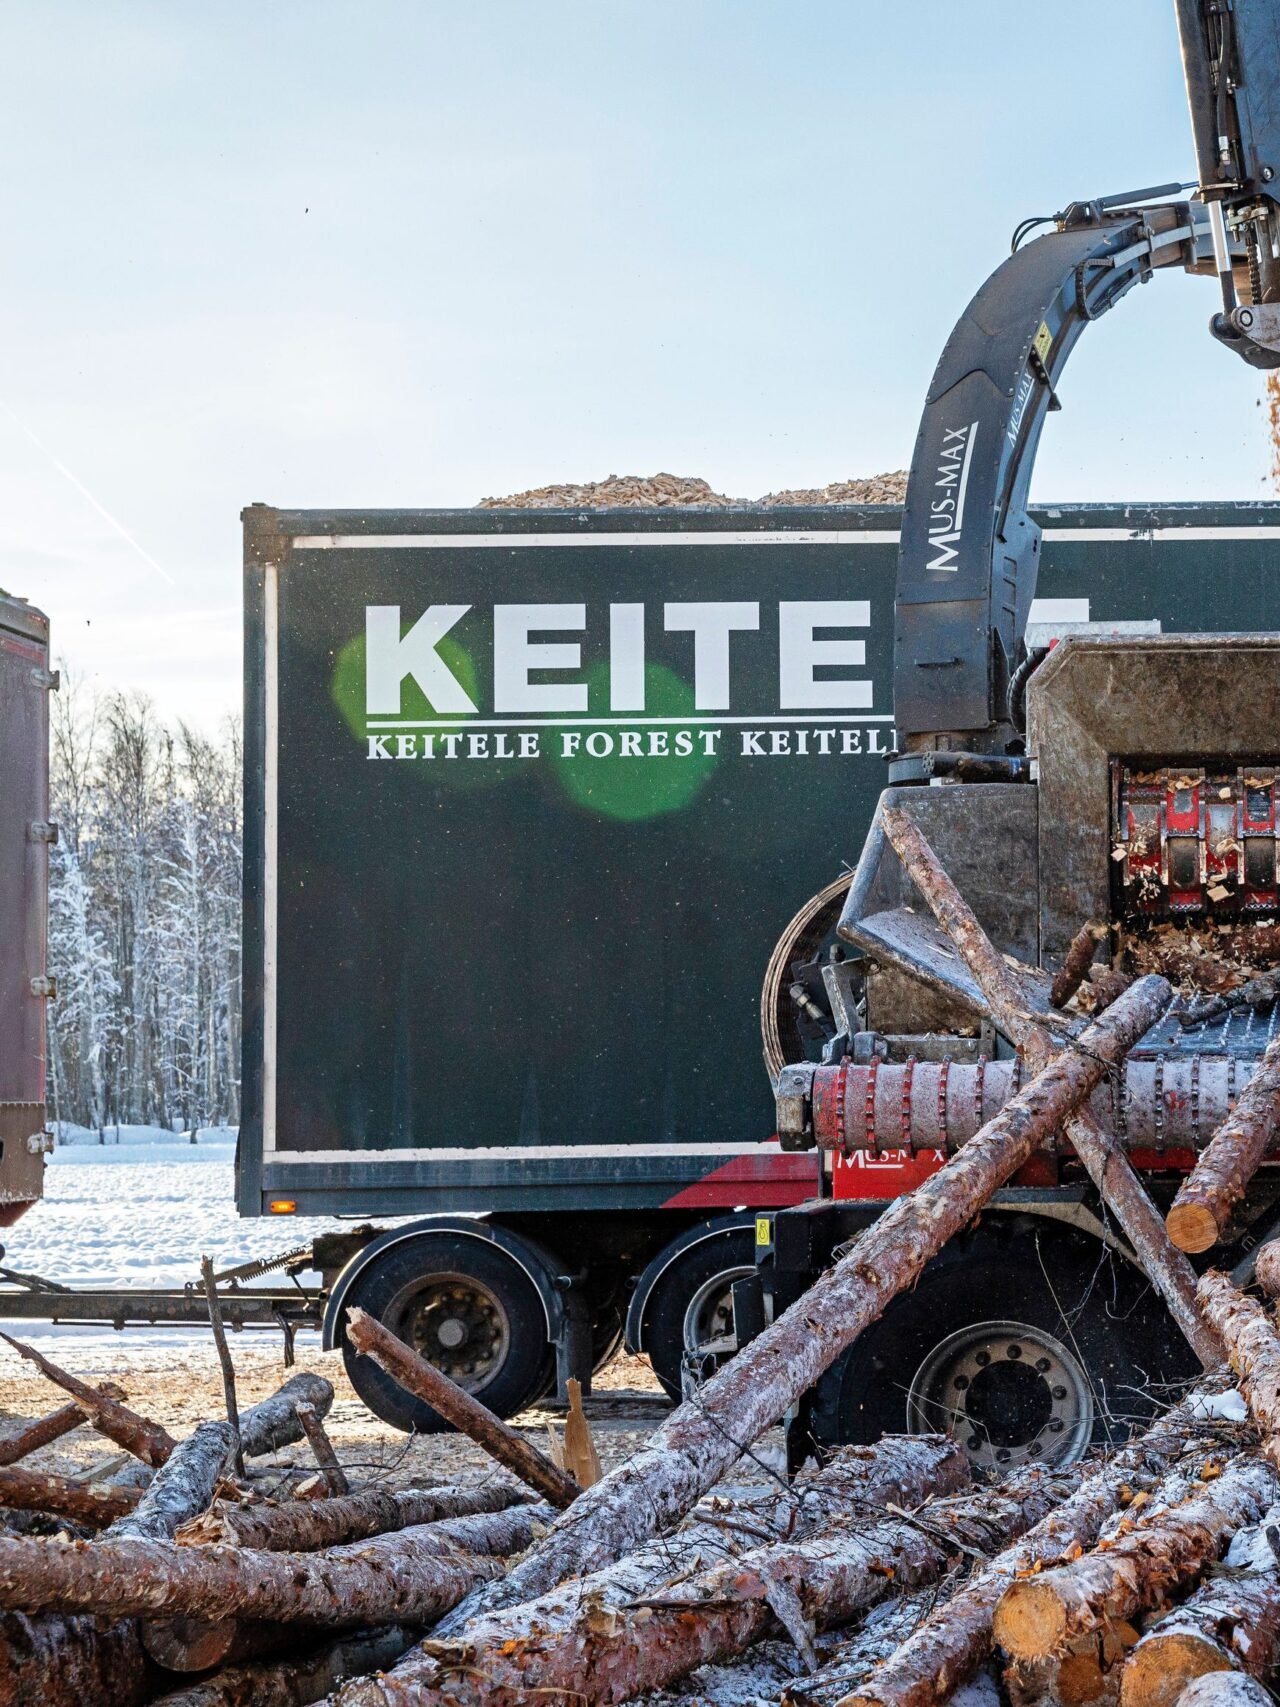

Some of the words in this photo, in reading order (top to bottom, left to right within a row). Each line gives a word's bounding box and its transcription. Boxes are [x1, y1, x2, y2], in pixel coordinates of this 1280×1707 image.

[926, 425, 969, 571] MUS-MAX
[365, 600, 1089, 714] KEITE
[366, 732, 541, 760] KEITELE
[560, 729, 721, 757] FOREST
[740, 728, 898, 756] KEITEL
